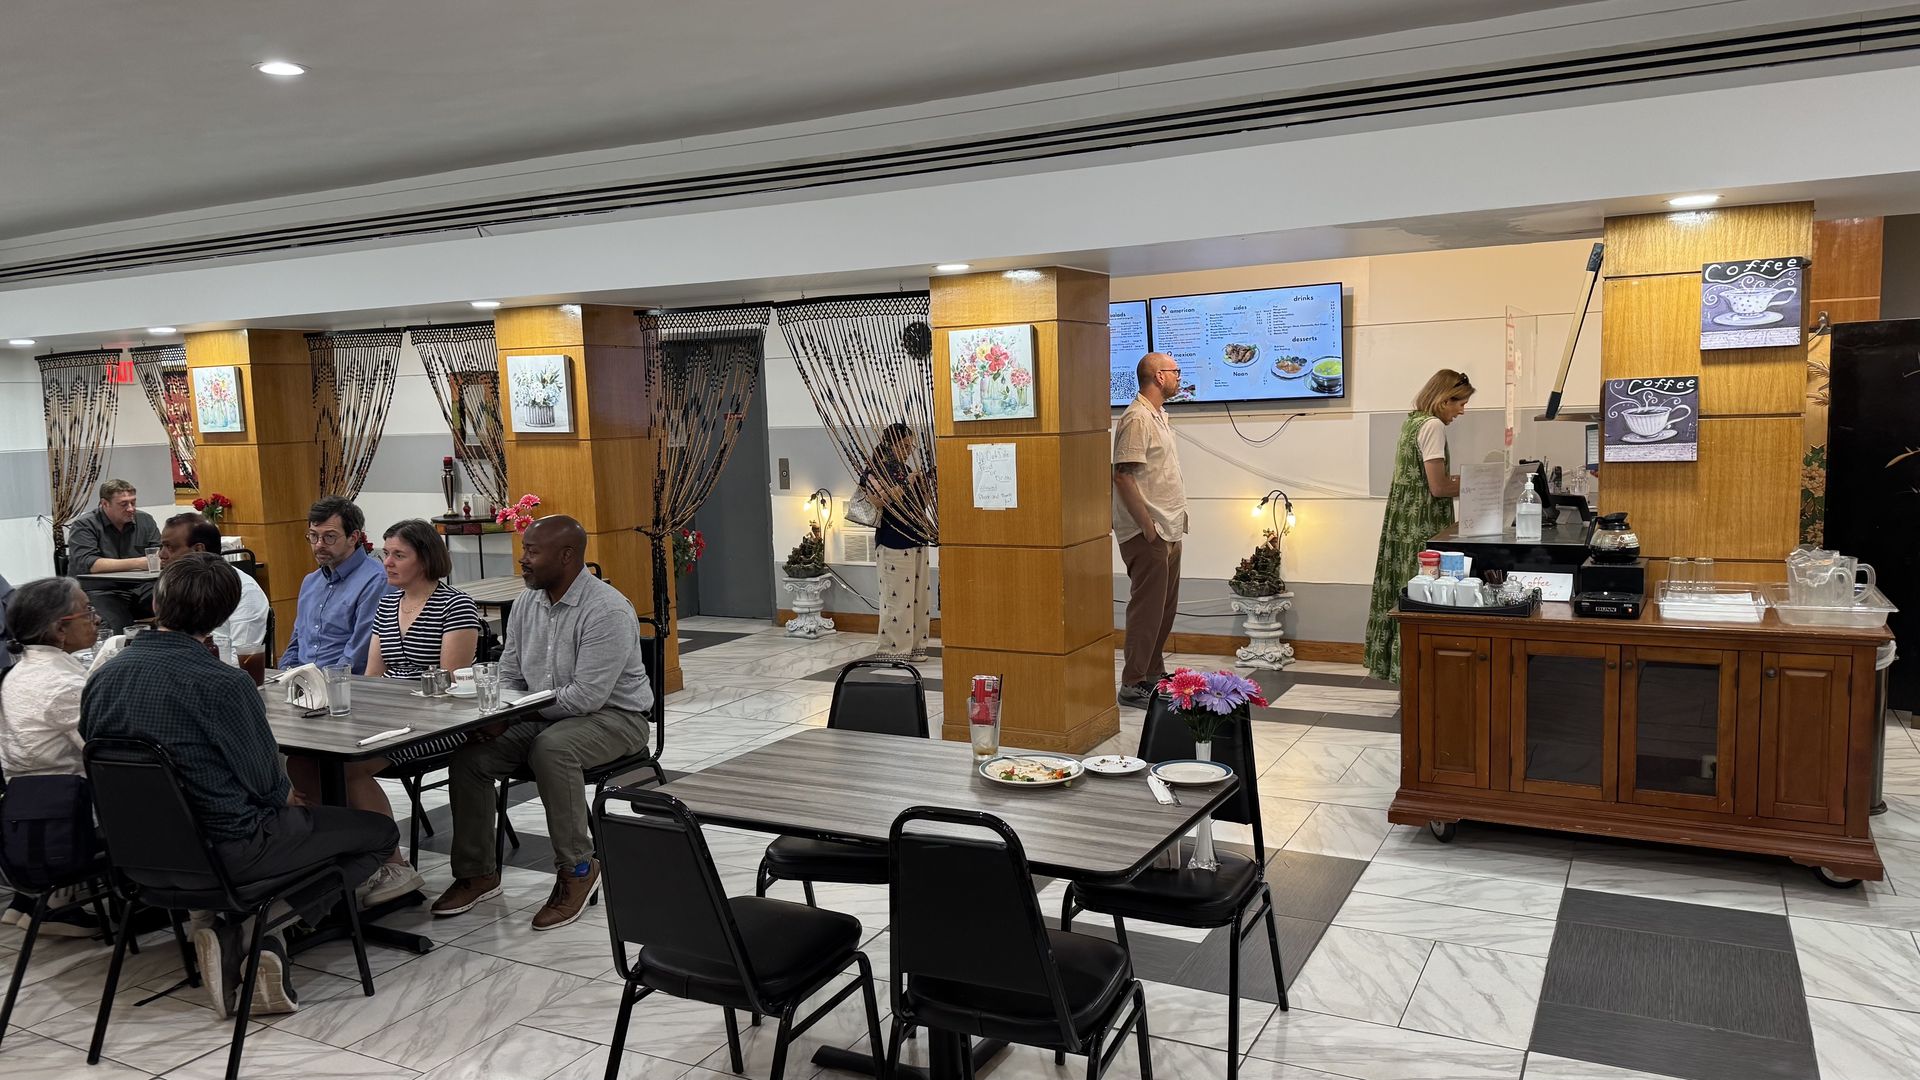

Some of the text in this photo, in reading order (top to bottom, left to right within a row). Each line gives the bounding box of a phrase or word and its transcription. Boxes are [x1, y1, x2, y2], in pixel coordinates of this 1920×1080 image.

[1705, 258, 1797, 283] Coffee
[1293, 294, 1314, 302] drinks
[1628, 378, 1696, 395] Coffee
